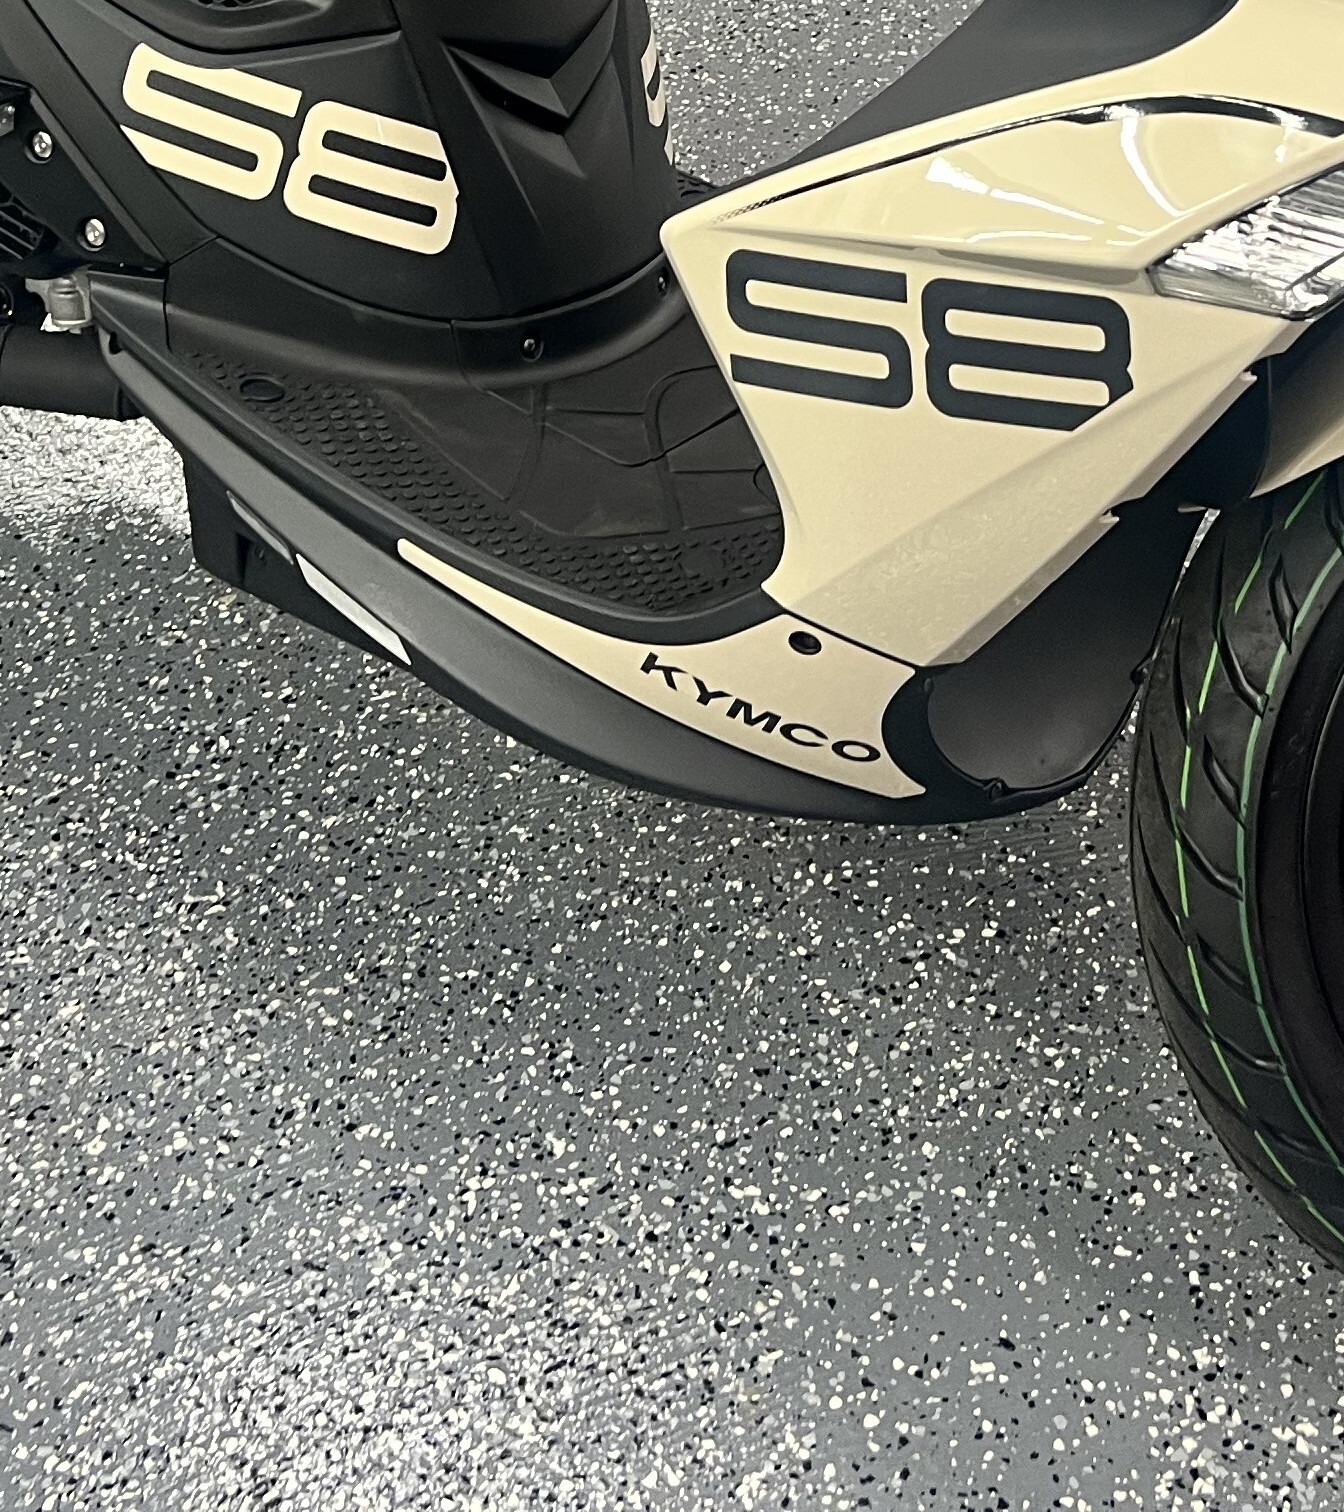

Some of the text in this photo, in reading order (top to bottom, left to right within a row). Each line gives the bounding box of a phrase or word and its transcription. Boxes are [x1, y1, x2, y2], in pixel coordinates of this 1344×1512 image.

[120, 42, 460, 257] S8
[725, 248, 1134, 432] S8
[640, 651, 882, 763] KYMCO
